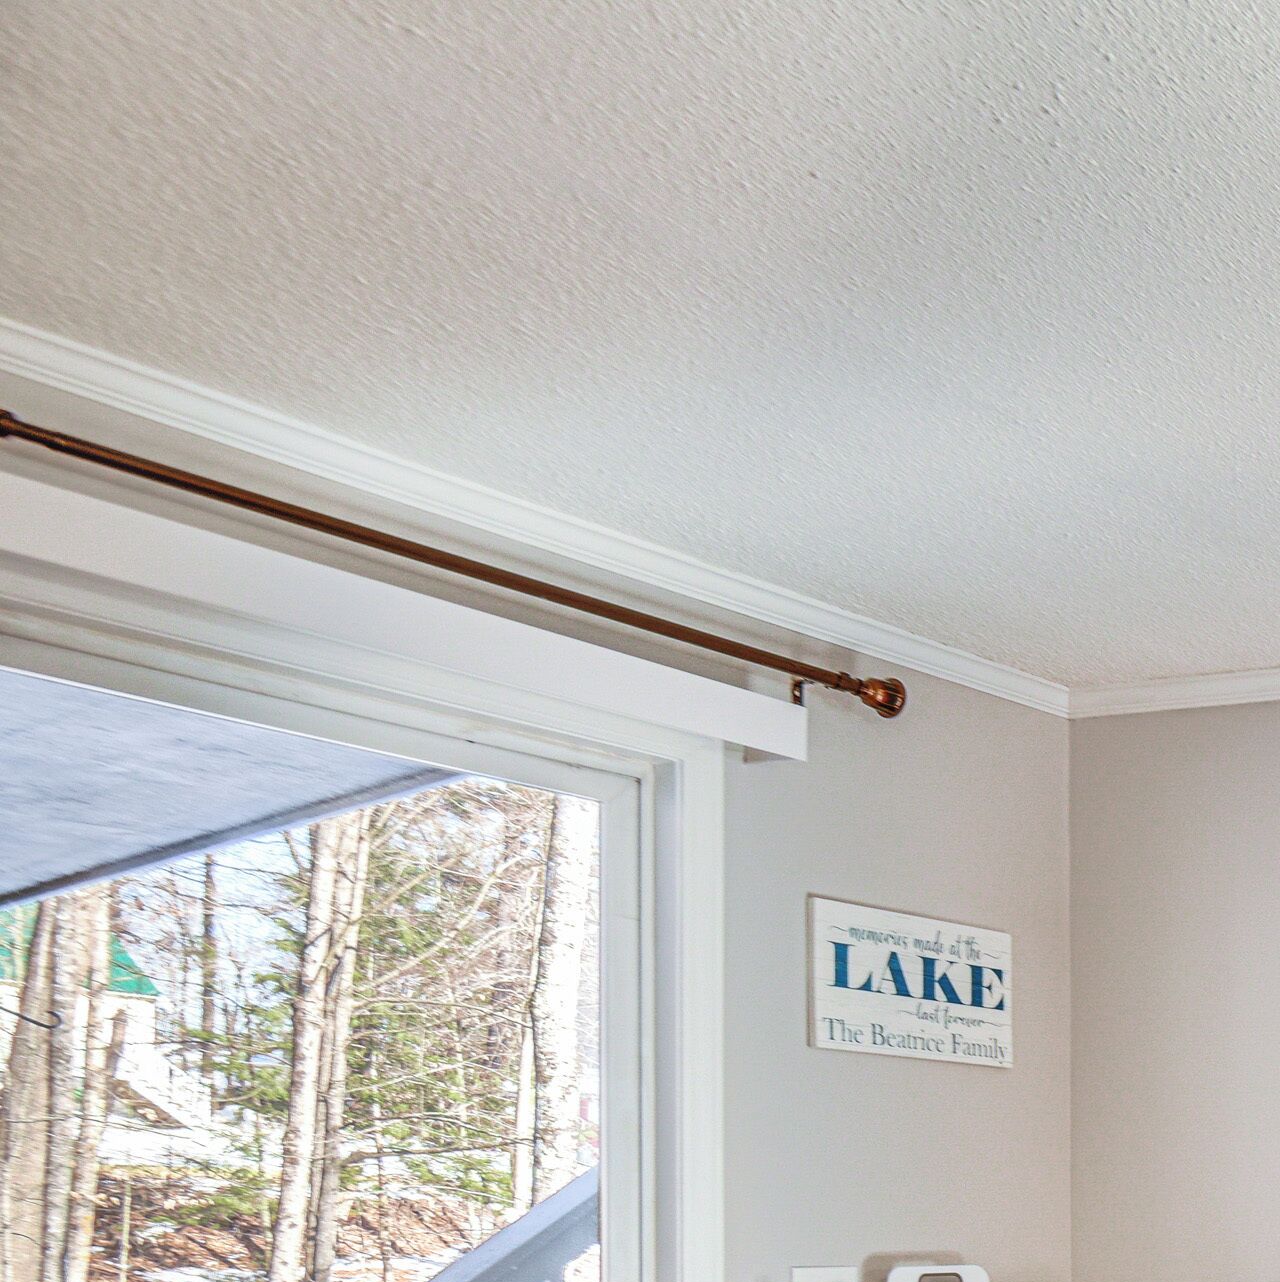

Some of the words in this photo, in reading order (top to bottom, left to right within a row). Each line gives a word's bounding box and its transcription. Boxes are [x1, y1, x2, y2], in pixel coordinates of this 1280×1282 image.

[914, 930, 944, 955] made
[826, 940, 1005, 1011] LAKE
[822, 1017, 864, 1044] The
[870, 1022, 945, 1053] Beatrice
[951, 1033, 1008, 1065] Family
